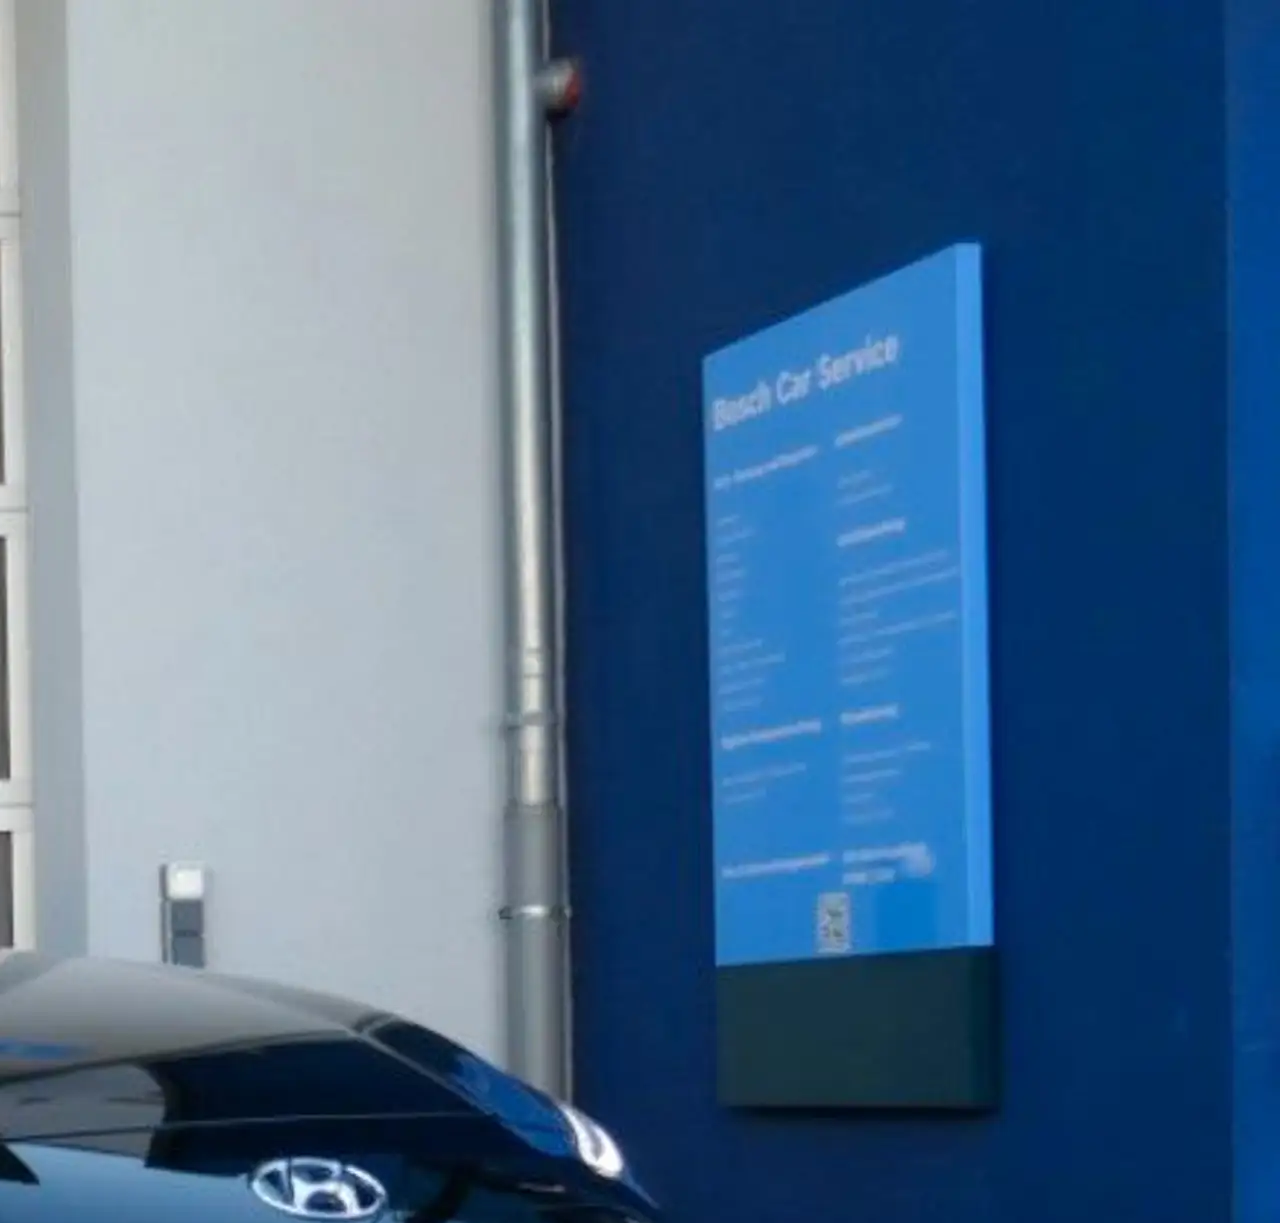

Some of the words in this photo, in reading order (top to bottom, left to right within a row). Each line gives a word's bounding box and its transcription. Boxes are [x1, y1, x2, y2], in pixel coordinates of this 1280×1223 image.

[713, 380, 771, 431] Bosch
[775, 369, 811, 406] Car
[818, 333, 899, 390] Service
